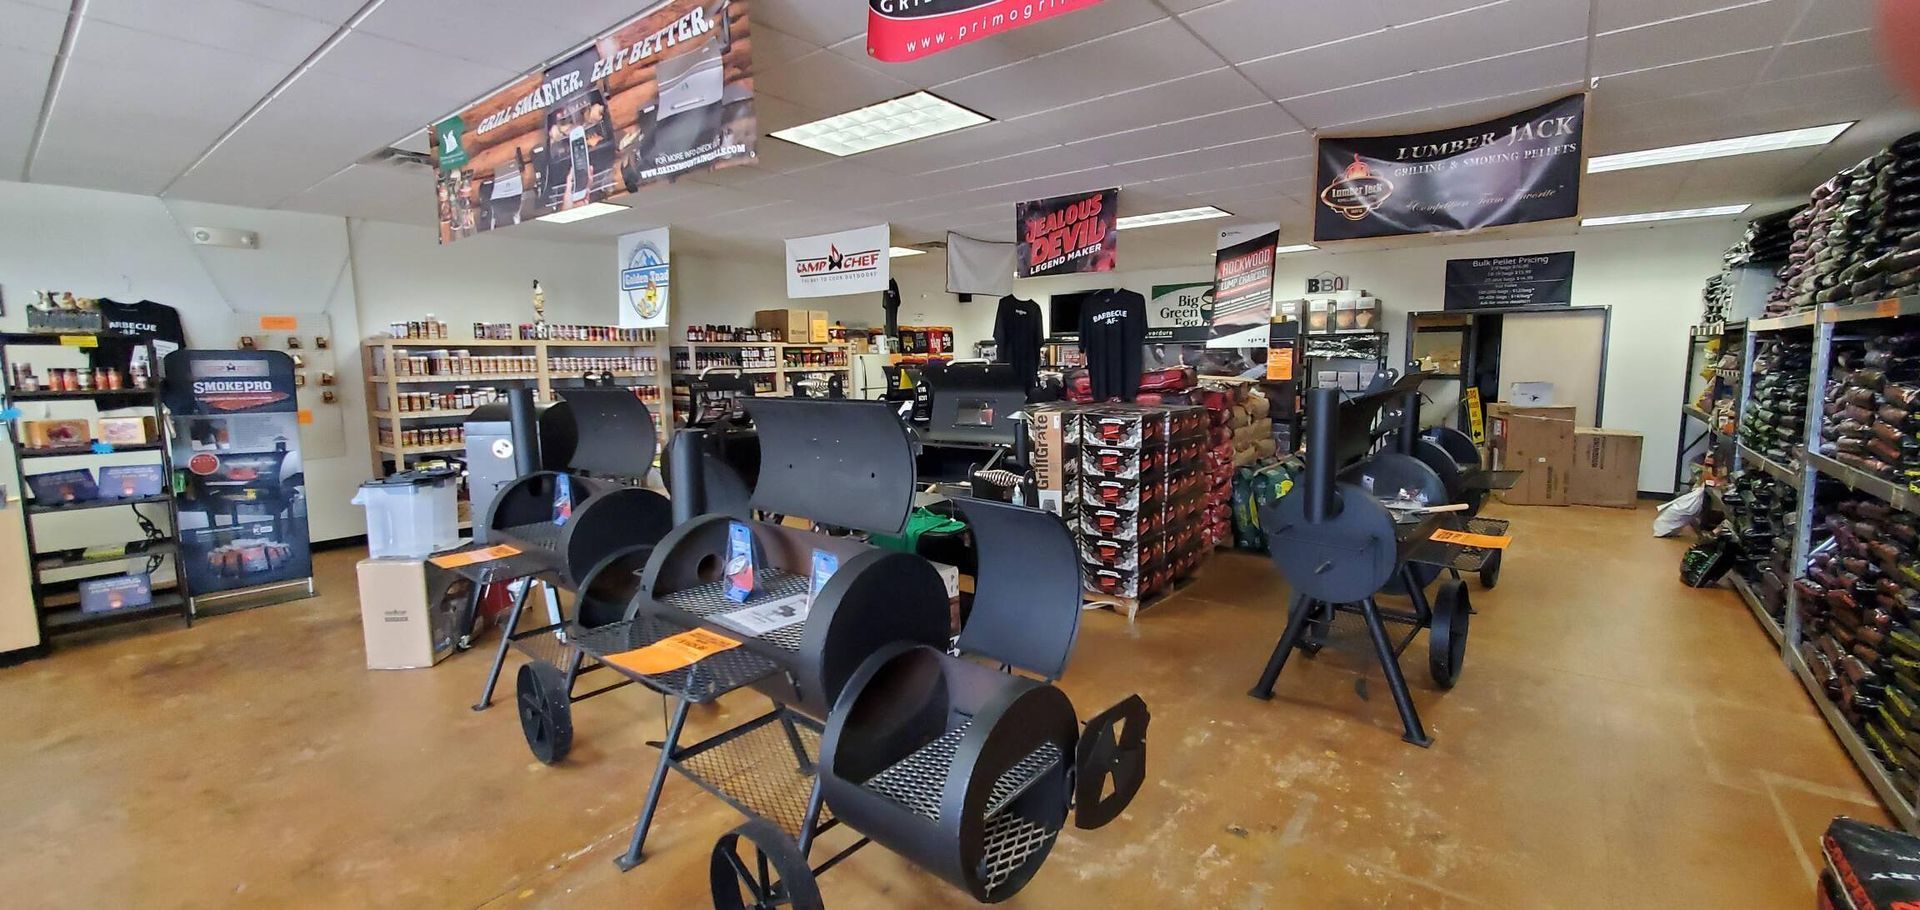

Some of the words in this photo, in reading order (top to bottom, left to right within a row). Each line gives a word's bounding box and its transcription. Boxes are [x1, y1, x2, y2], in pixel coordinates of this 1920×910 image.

[477, 106, 512, 135] GRILL
[512, 70, 584, 119] SMARTER.
[590, 47, 628, 83] EAT
[628, 6, 715, 65] BETTER.
[1396, 132, 1497, 160] LUMBER
[1507, 115, 1576, 146] JACK
[667, 151, 685, 162] MORE
[1394, 163, 1445, 177] GRILLING
[1450, 160, 1459, 170] &
[1463, 152, 1520, 169] SMOKING
[1524, 143, 1577, 159] PELLETS
[1332, 187, 1363, 198] Lumber
[1364, 183, 1383, 196] Jack
[1025, 193, 1103, 243] JEALOUS
[1030, 216, 1106, 266] DEVIL
[796, 261, 828, 274] CAMP
[843, 253, 879, 269] CHEF
[1030, 256, 1066, 275] LEGEND
[1067, 243, 1102, 262] MAKER
[1222, 248, 1271, 277] ROCKWOOD
[1472, 260, 1490, 268] Bulk
[1492, 258, 1516, 267] Pellet
[1518, 256, 1549, 265] Pricing
[1221, 279, 1238, 290] LUMP
[1308, 276, 1344, 293] BBQ
[1178, 295, 1200, 308] Big
[1092, 309, 1128, 322] BARBECUE
[1160, 307, 1198, 319] Green
[109, 321, 157, 332] ARBECUE
[193, 380, 272, 394] SMOKEPRO
[1035, 414, 1049, 490] GrillGrate
